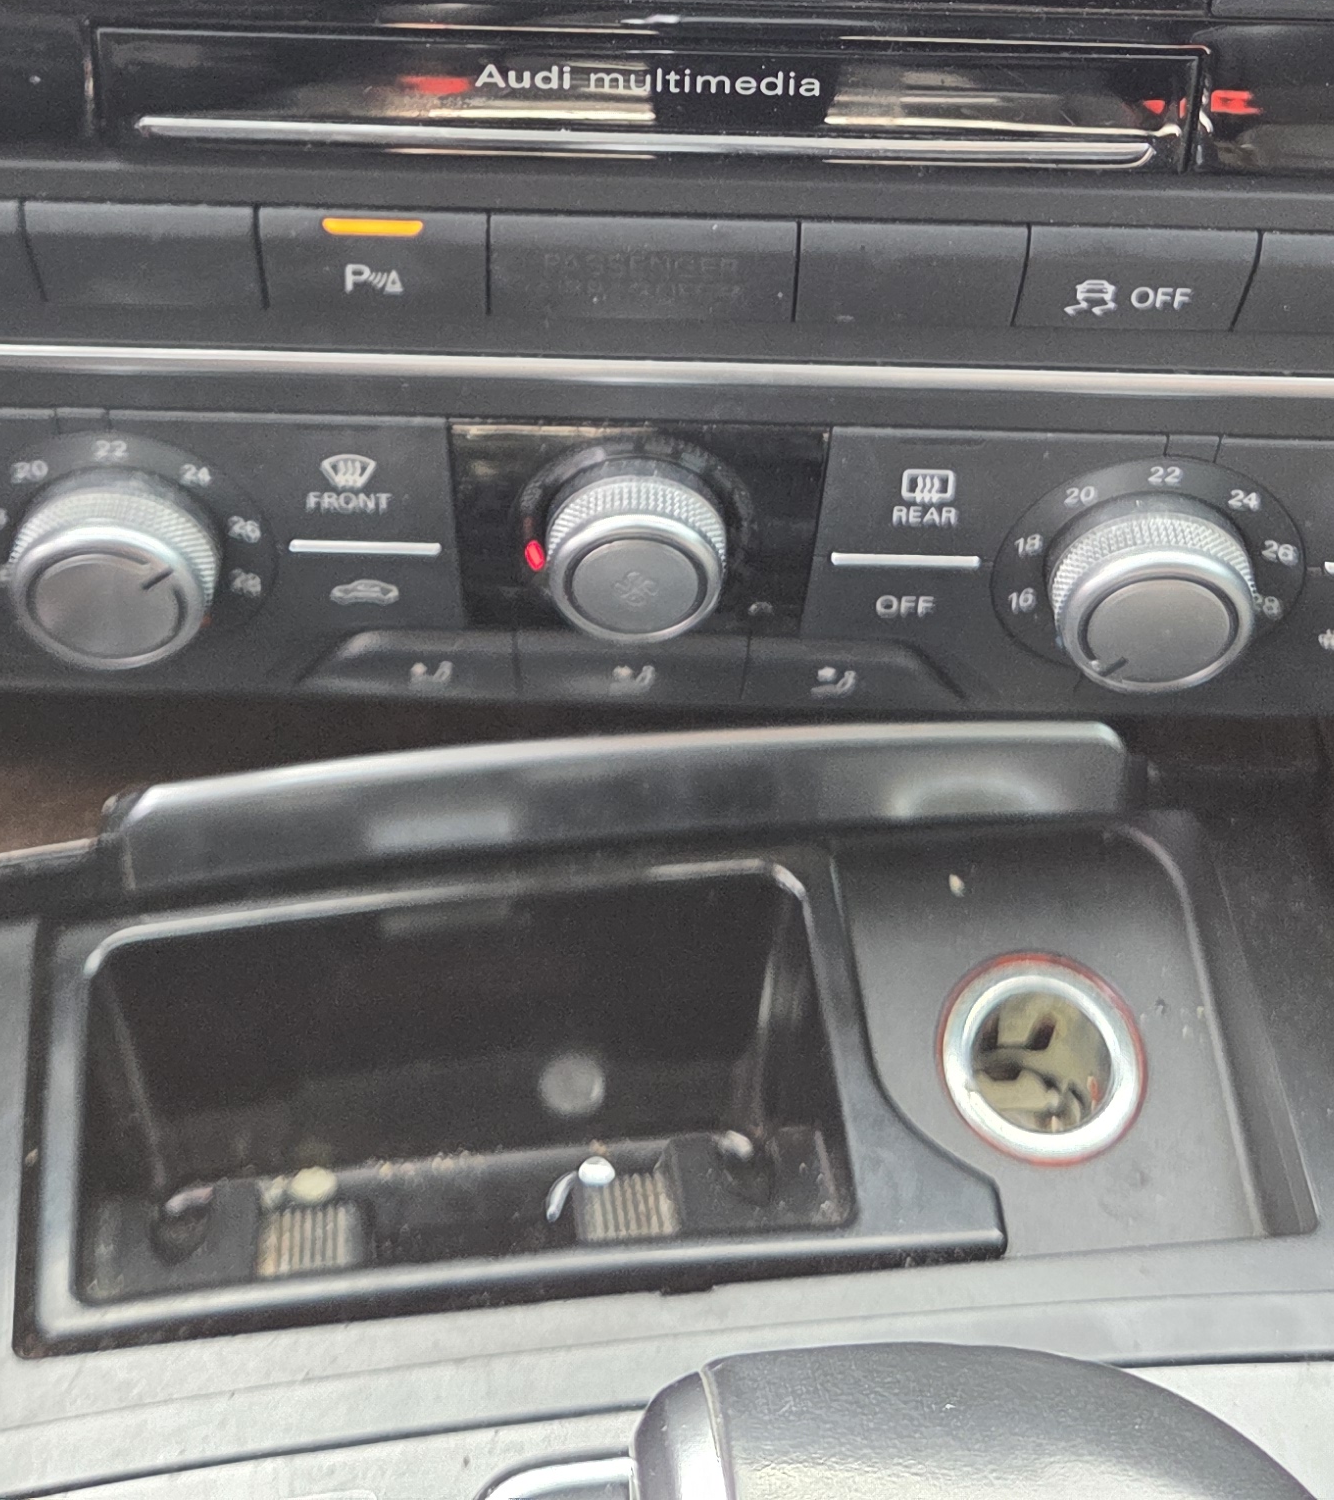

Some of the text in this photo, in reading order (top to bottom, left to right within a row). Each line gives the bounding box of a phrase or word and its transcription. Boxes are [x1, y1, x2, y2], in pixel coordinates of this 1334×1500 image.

[474, 63, 821, 98] Audi multimedia
[1130, 286, 1194, 311] OFF
[91, 439, 128, 463] 22
[11, 459, 48, 484] 20
[178, 463, 212, 488] 24
[1147, 466, 1183, 487] 22
[305, 491, 393, 514] FRONT
[1064, 486, 1097, 508] 20
[1227, 489, 1261, 512] 24
[892, 505, 959, 528] REAR
[1014, 533, 1043, 557] 18
[1262, 540, 1298, 566] 26
[875, 594, 936, 619] OFF
[1008, 587, 1037, 614] 16
